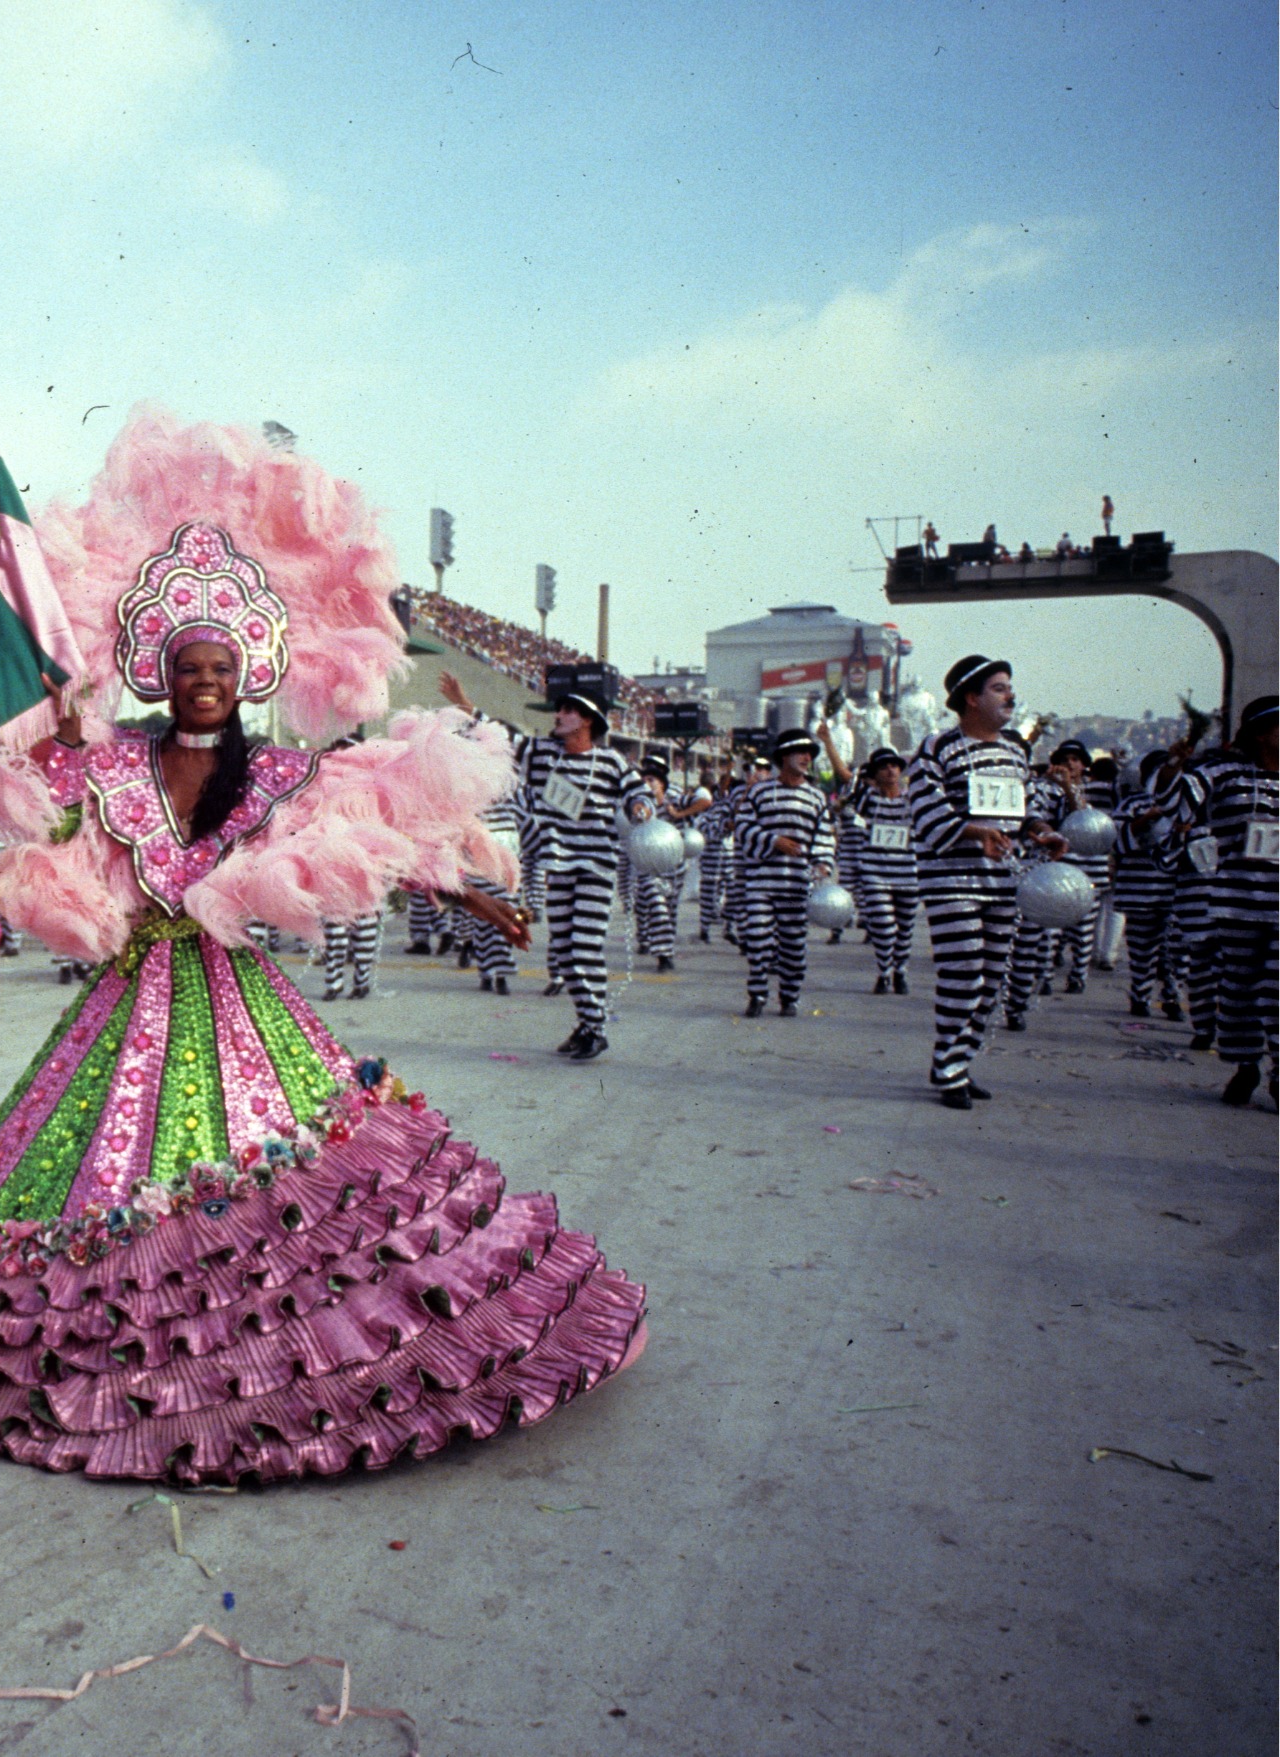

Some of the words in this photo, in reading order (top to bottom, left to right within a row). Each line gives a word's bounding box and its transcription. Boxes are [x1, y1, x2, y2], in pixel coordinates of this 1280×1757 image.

[549, 781, 580, 814] 171
[976, 782, 1017, 807] 171
[876, 828, 905, 844] 171
